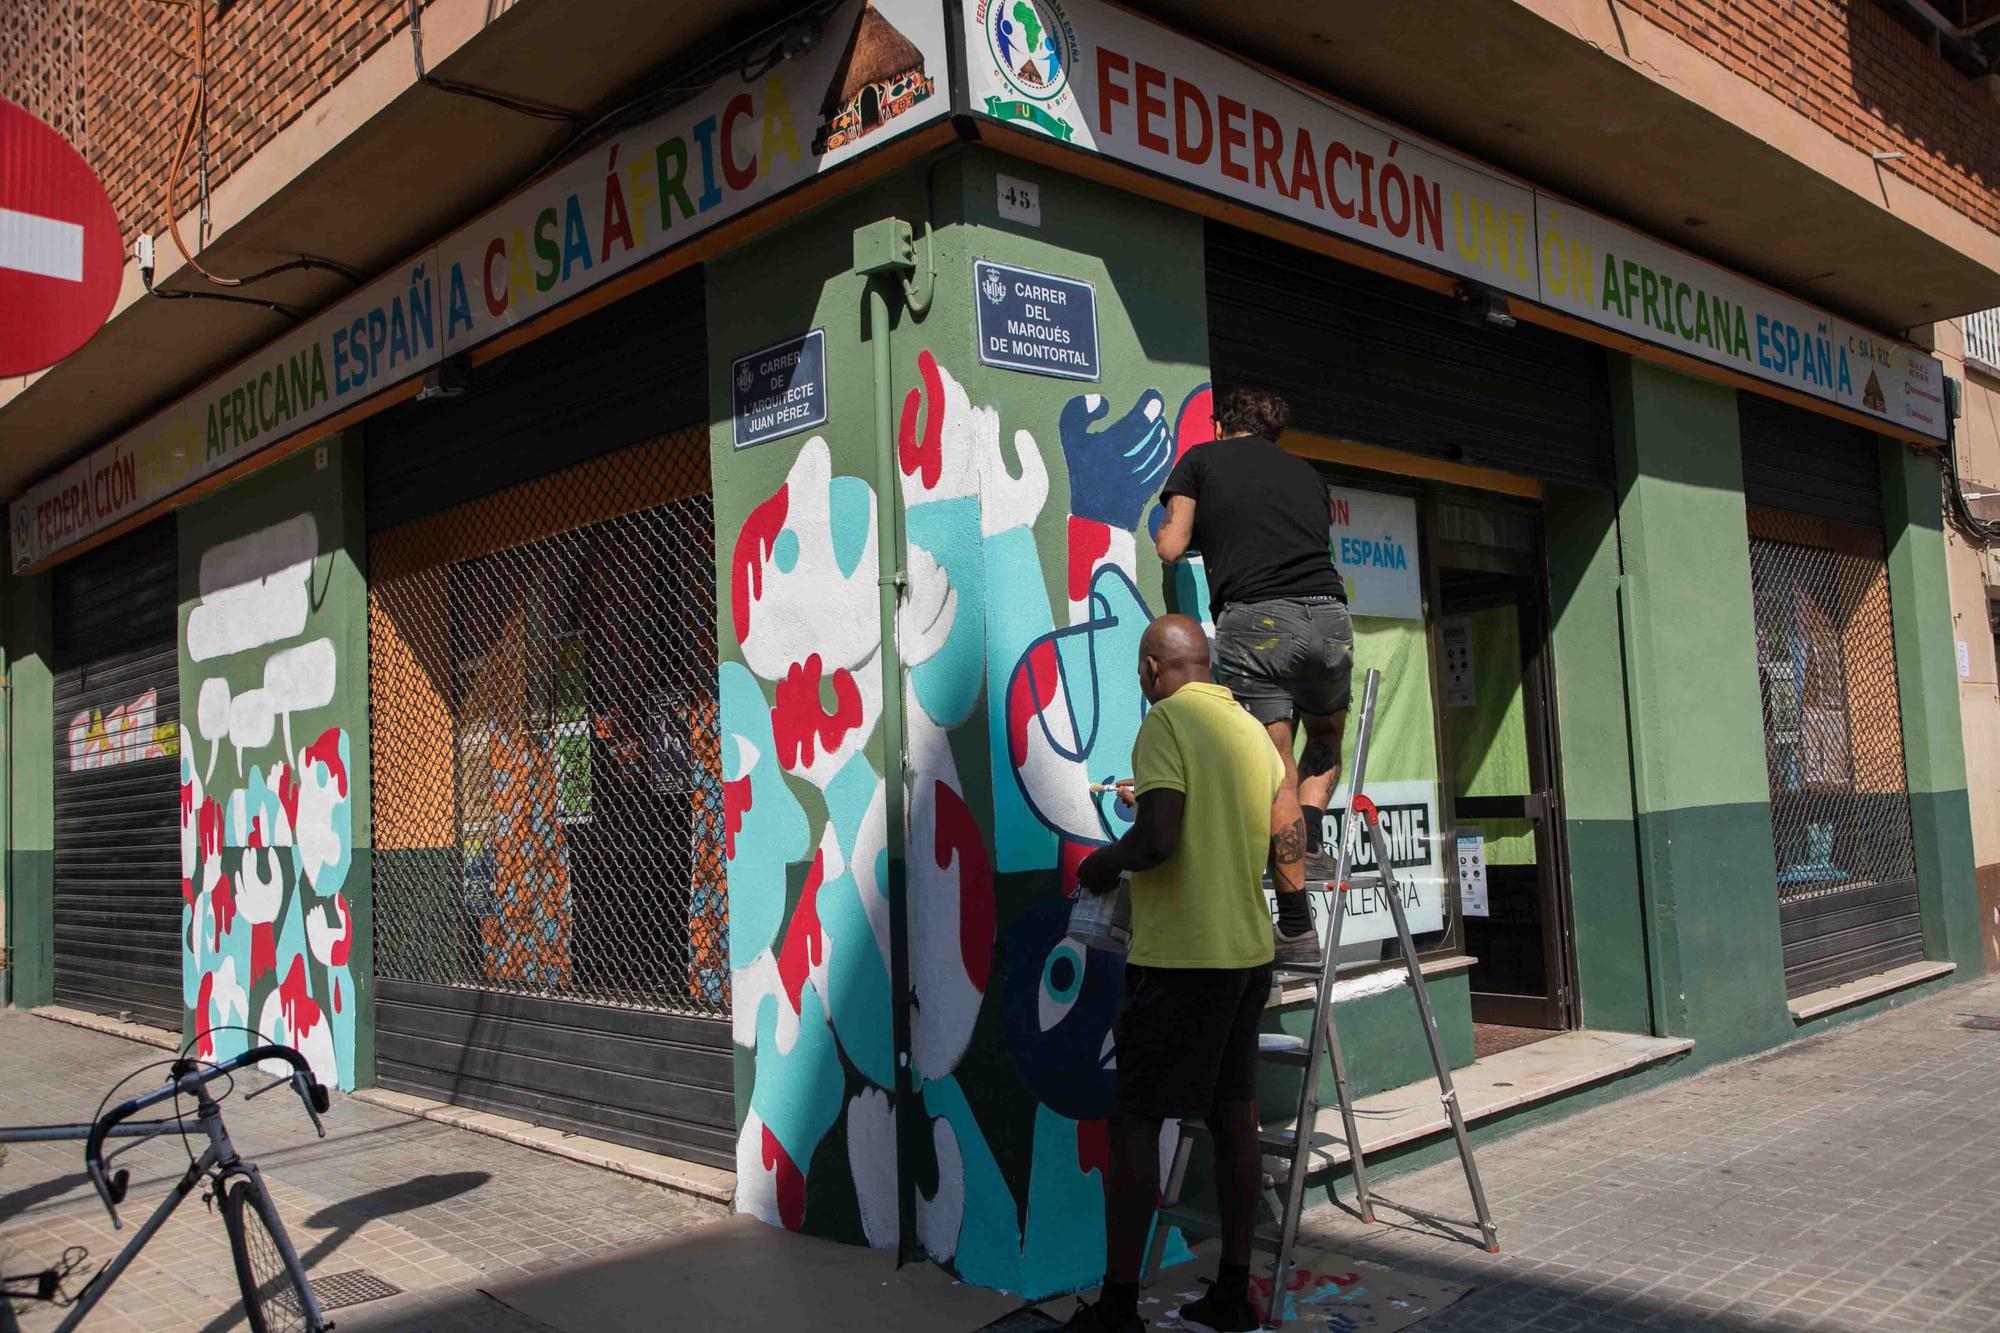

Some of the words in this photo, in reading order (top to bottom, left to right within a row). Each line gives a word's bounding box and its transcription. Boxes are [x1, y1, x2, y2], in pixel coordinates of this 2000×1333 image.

[1004, 187, 1030, 209] 45
[1096, 45, 1444, 251] FEDERACIÓN
[1453, 191, 1595, 305] UNIÓN
[1602, 252, 1751, 361] AFRICANA
[1755, 313, 1853, 396] ESPAÑA
[1015, 282, 1067, 305] CARRER
[37, 446, 137, 546] FEDERACIÓN
[206, 342, 328, 461] AFRICANA
[484, 194, 593, 317] CASA
[601, 73, 800, 263] ÁFRICA
[1025, 304, 1051, 322] DEL
[1007, 320, 1071, 344] MARQUÉS
[760, 351, 801, 376] CARRER
[990, 336, 1009, 353] DE
[1012, 341, 1090, 367] MONTORTAL
[770, 375, 785, 391] DE
[743, 382, 815, 417] L'ARQUITECTE
[748, 414, 775, 433] JUAN
[776, 402, 811, 425] PÉREZ
[1340, 535, 1407, 570] ESPAÑA
